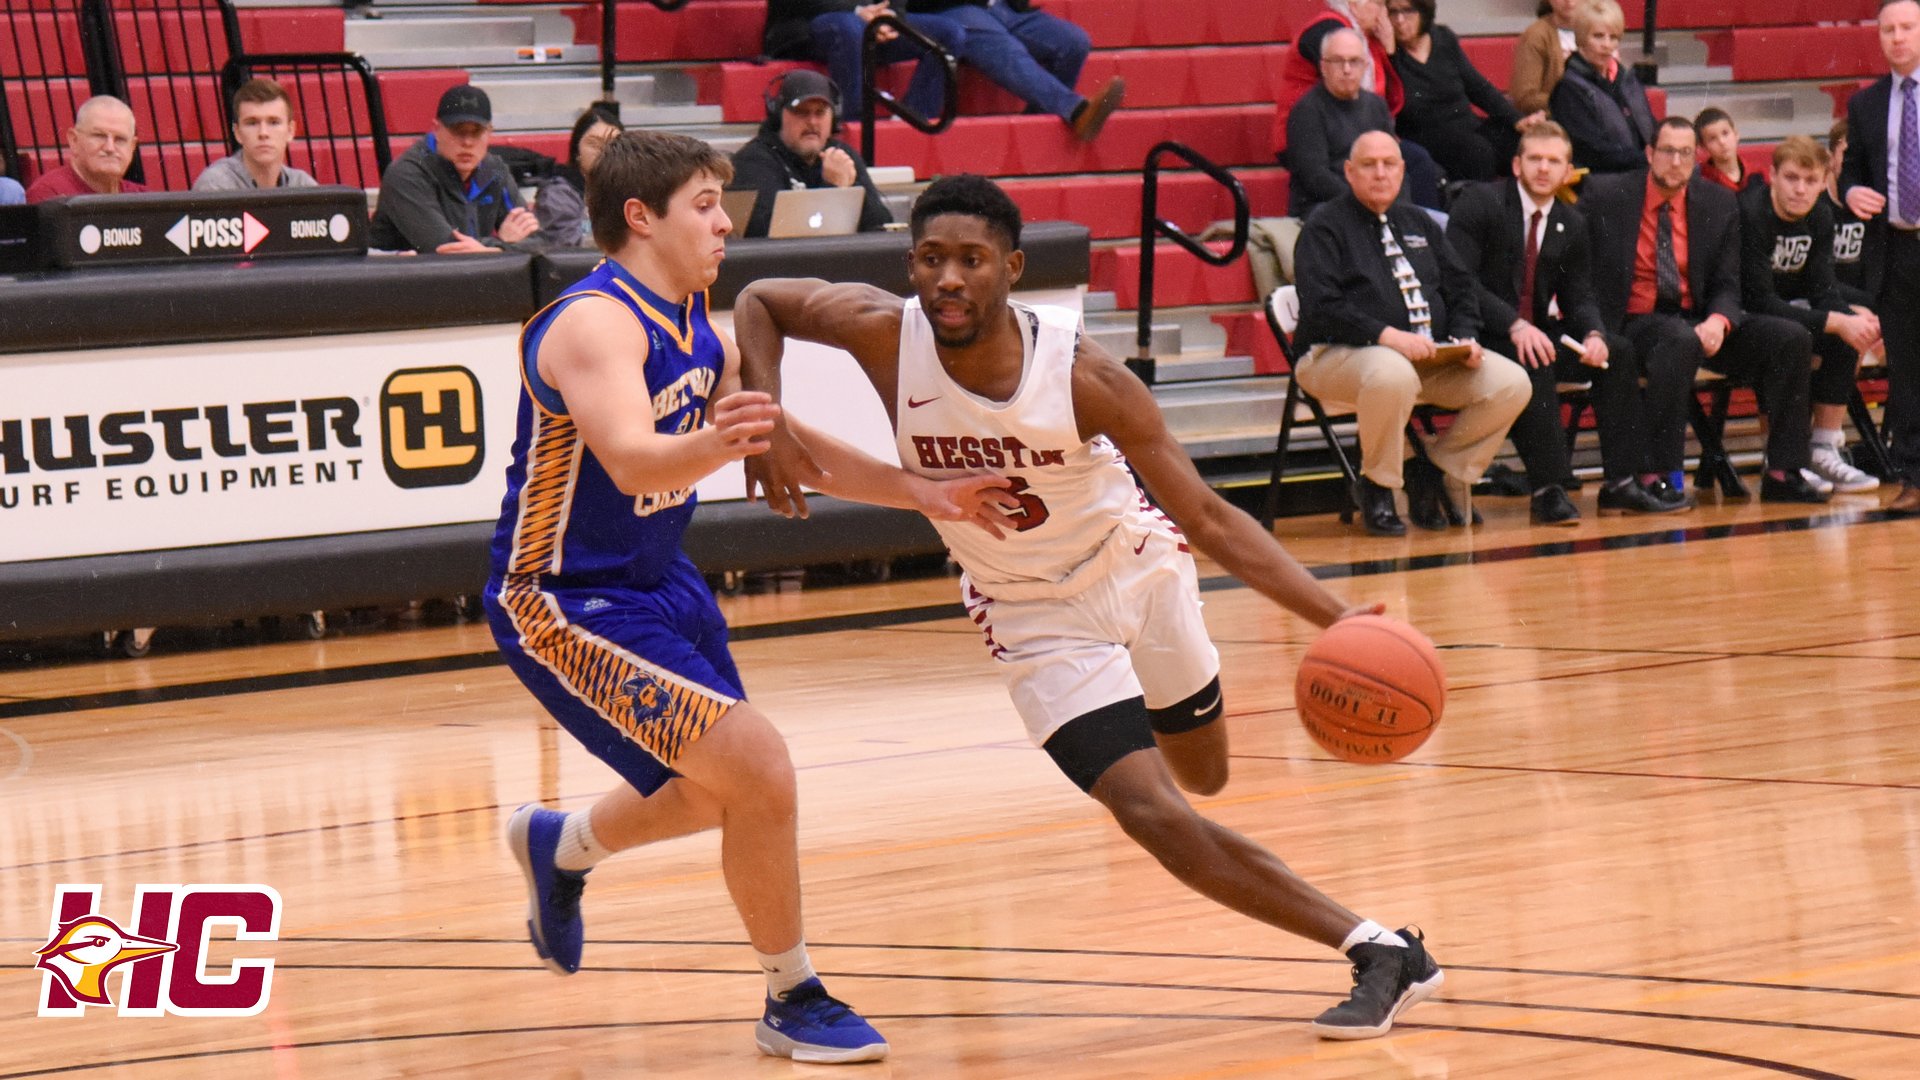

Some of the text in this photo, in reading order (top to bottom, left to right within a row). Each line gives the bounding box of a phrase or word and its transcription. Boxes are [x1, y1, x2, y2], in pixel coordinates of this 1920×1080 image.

[103, 227, 142, 247] BONUS
[190, 217, 243, 248] POSS
[290, 219, 328, 239] BONUS
[106, 459, 362, 501] EQUIPMENT
